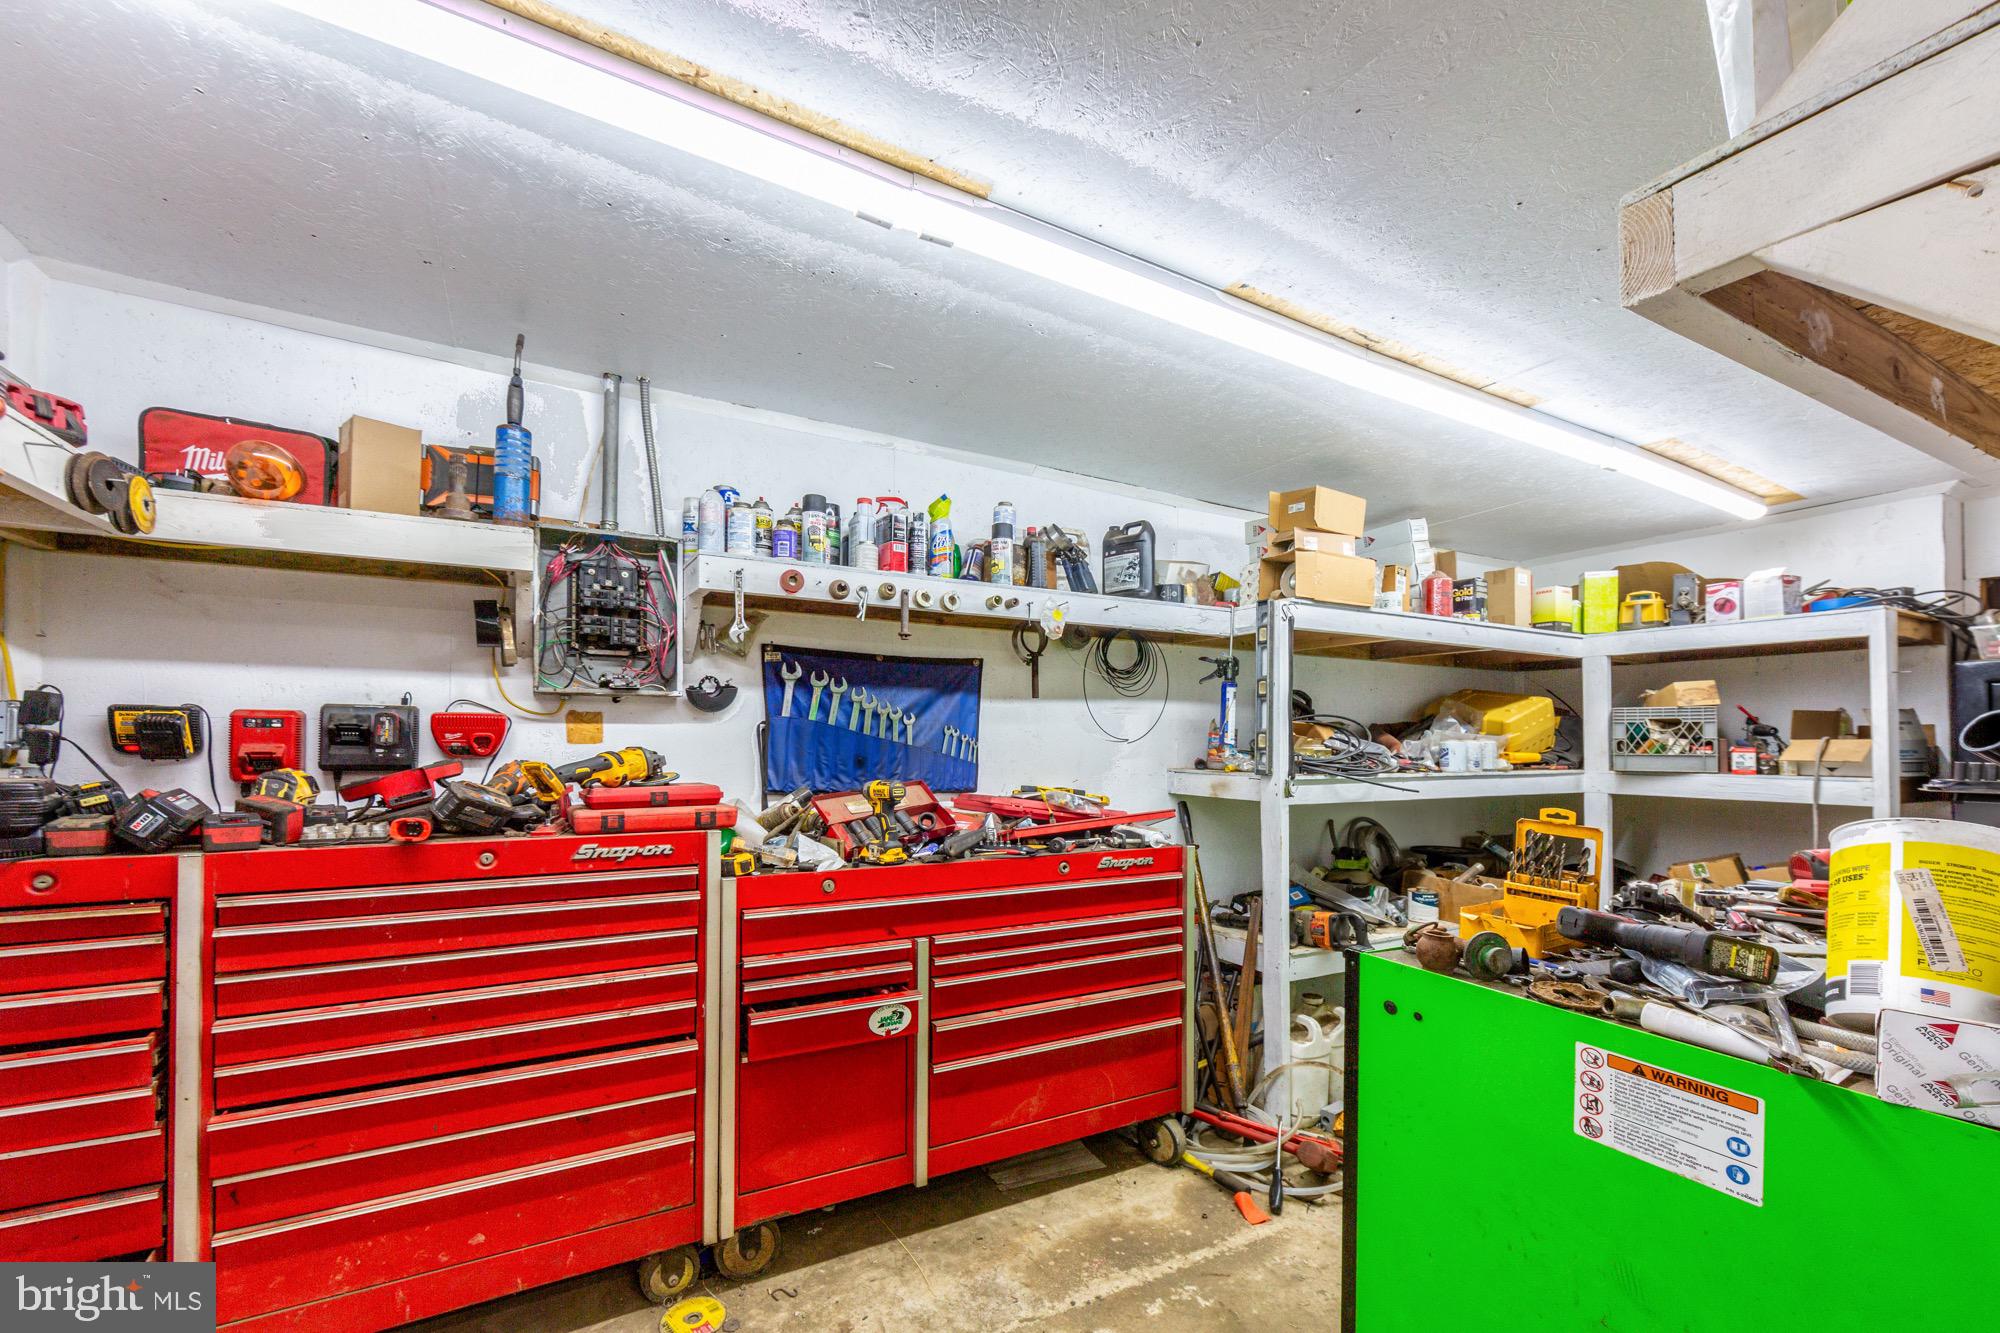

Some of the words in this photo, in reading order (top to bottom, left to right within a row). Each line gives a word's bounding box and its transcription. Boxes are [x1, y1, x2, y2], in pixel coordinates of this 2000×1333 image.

[1453, 587, 1473, 597] Gold
[571, 843, 674, 863] Snap-on
[1097, 856, 1154, 870] Snap-on
[1842, 873, 1864, 883] USES
[1915, 1026, 1945, 1051] PARTS
[1920, 1025, 1950, 1049] AGCO
[1881, 1041, 1927, 1079] Original
[1651, 1069, 1729, 1103] WARNING
[1920, 1083, 1949, 1108] PARTS
[1925, 1081, 1955, 1106] AGCO
